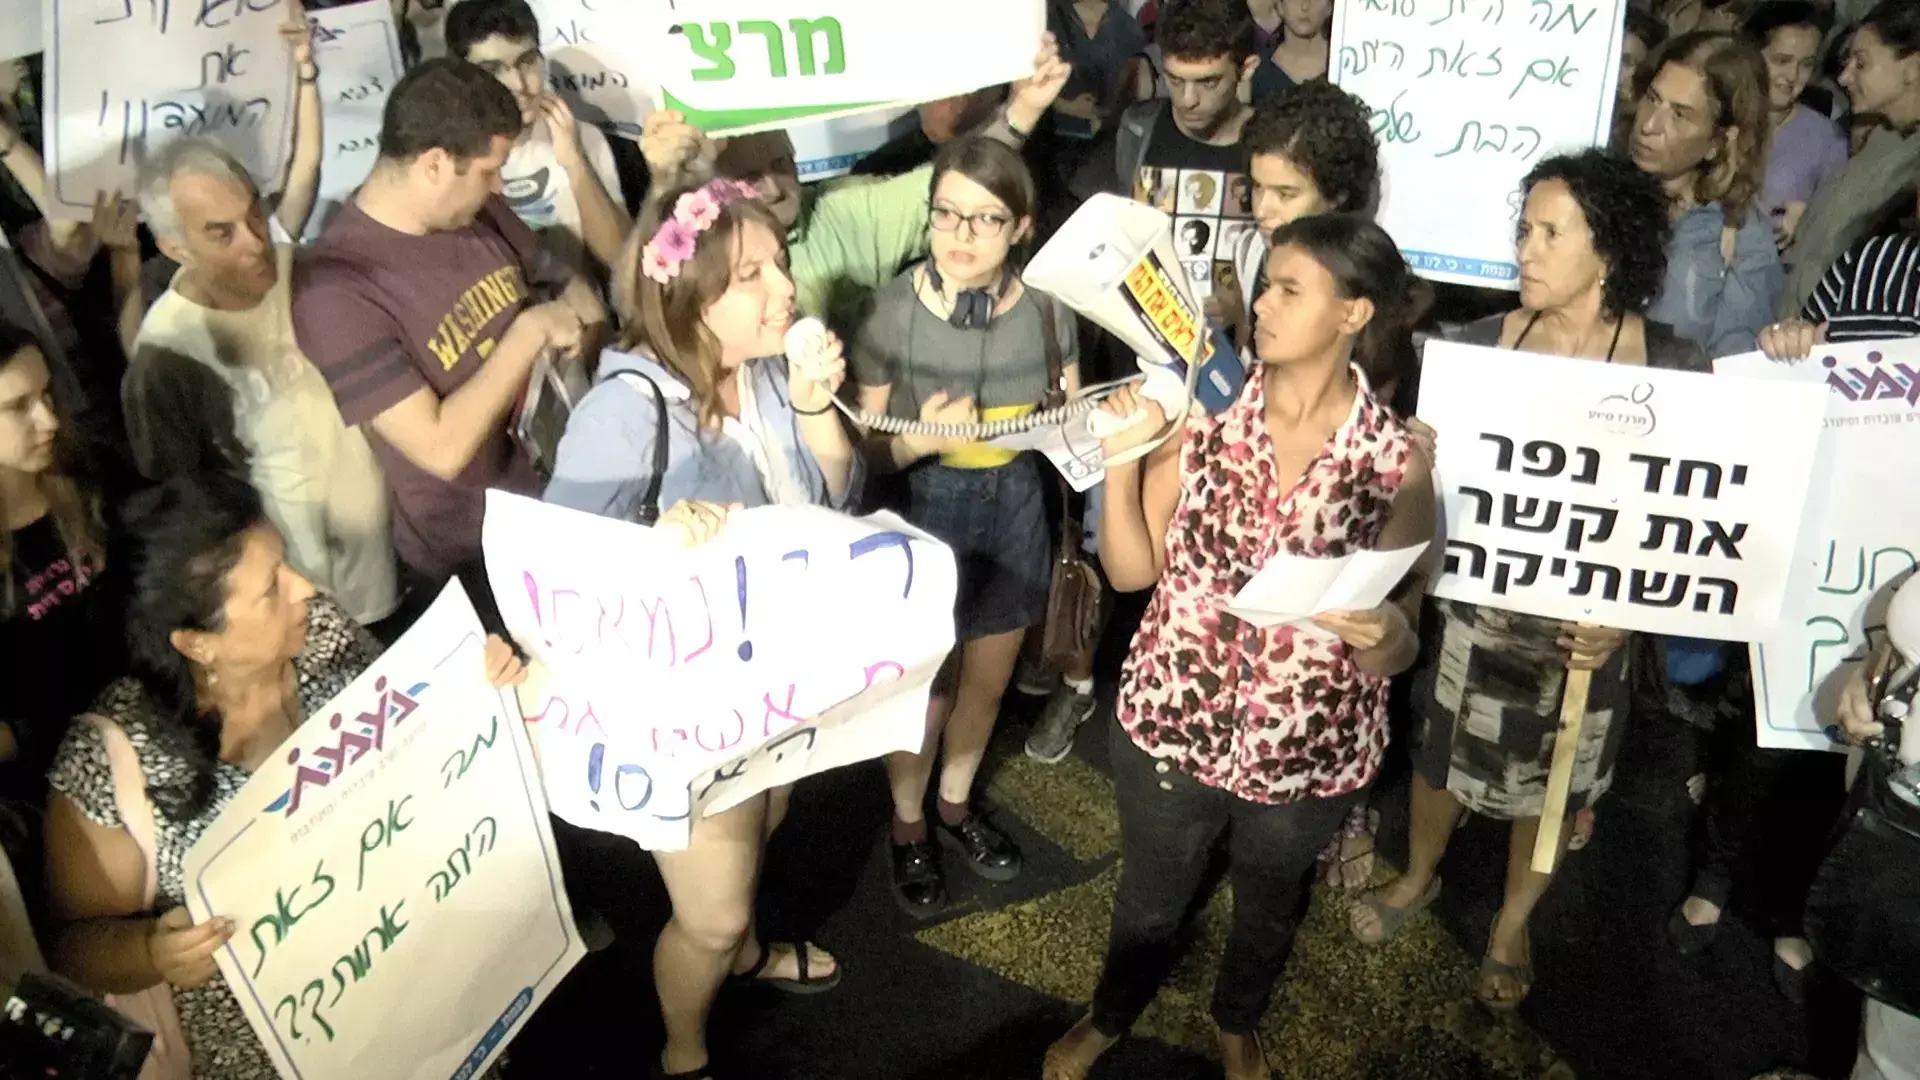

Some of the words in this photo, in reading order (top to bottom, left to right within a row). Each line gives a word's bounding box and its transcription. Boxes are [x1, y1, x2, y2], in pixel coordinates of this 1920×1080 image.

[681, 15, 846, 82] מרצ
[1417, 40, 1502, 78] זאת
[1508, 55, 1579, 100] אם
[1434, 120, 1541, 161] הבת
[1479, 433, 1600, 485] נפר
[1629, 453, 1748, 500] יחד
[1458, 486, 1619, 552] קשר
[1639, 514, 1748, 560] את
[1443, 540, 1739, 615] השתיקה
[440, 716, 497, 788] מה
[357, 795, 414, 891] אם
[250, 860, 335, 979] זאת
